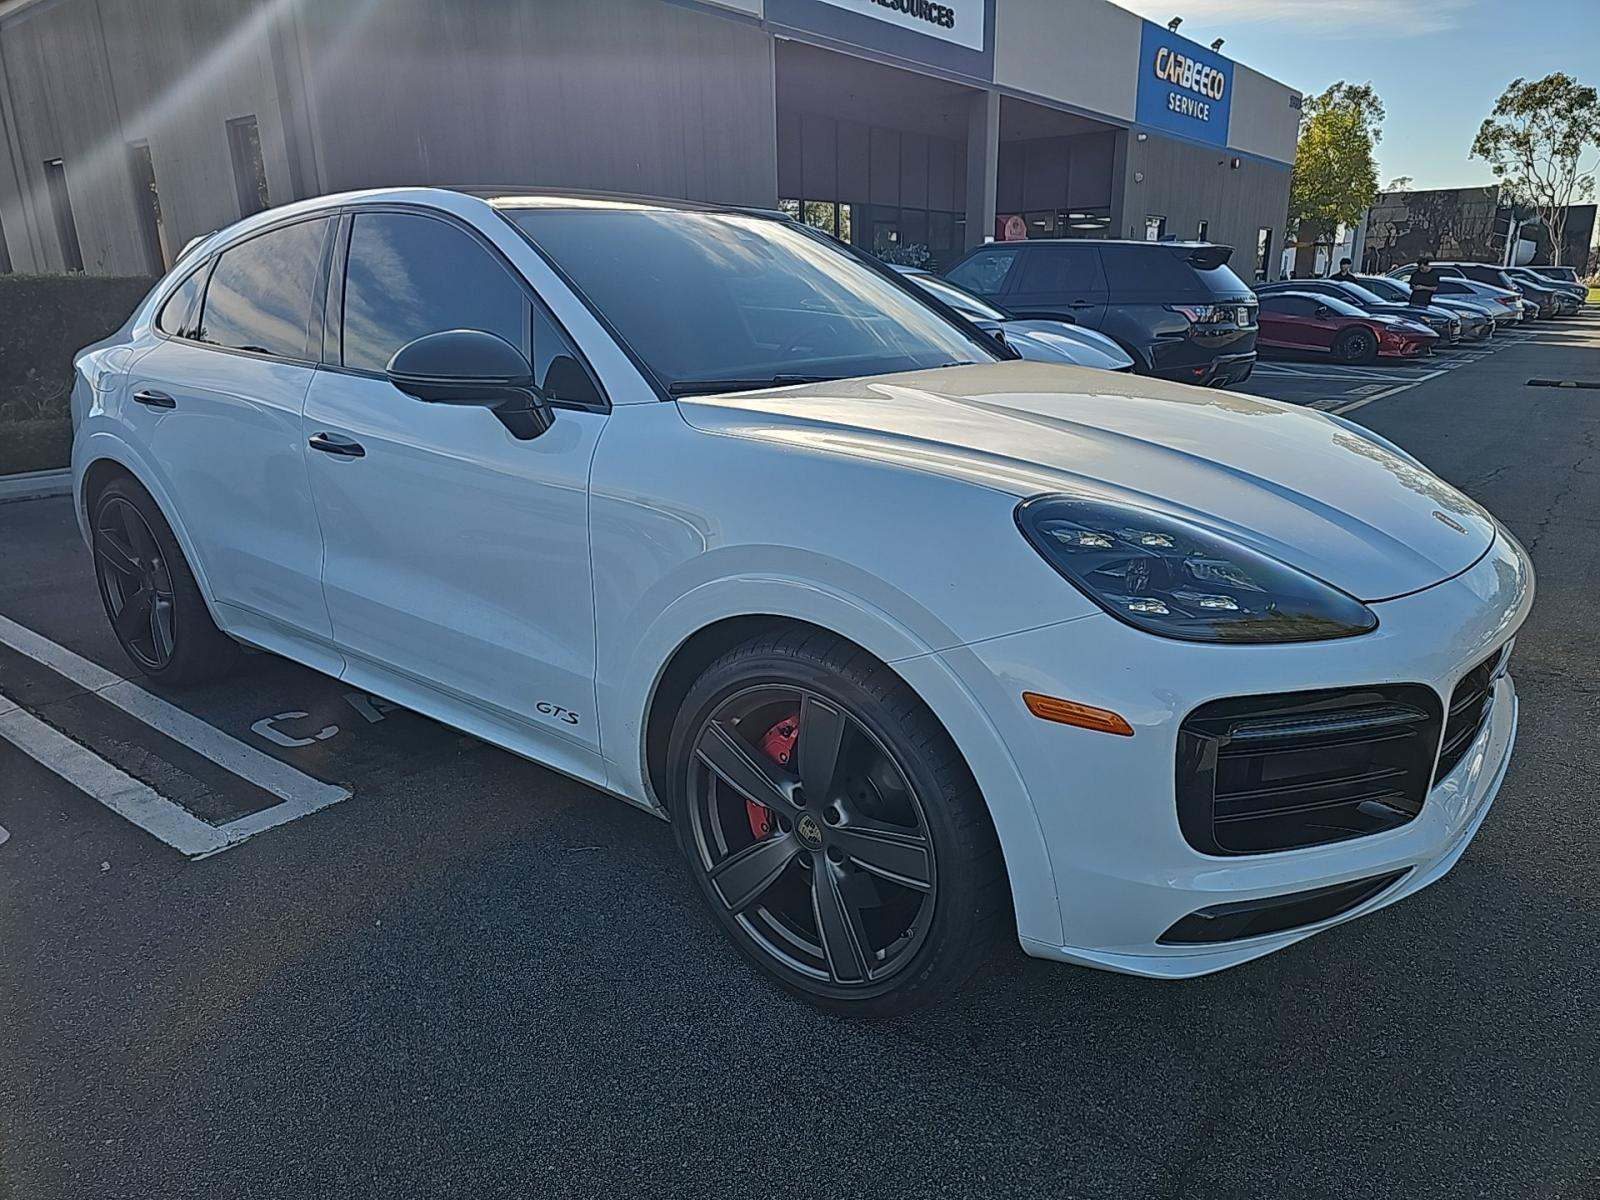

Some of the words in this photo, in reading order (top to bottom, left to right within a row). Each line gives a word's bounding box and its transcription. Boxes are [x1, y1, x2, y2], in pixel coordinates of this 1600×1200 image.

[870, 0, 955, 29] SOURCES
[1155, 47, 1225, 100] CARBEECO
[1168, 92, 1210, 121] SERVICE
[536, 702, 579, 725] GTS
